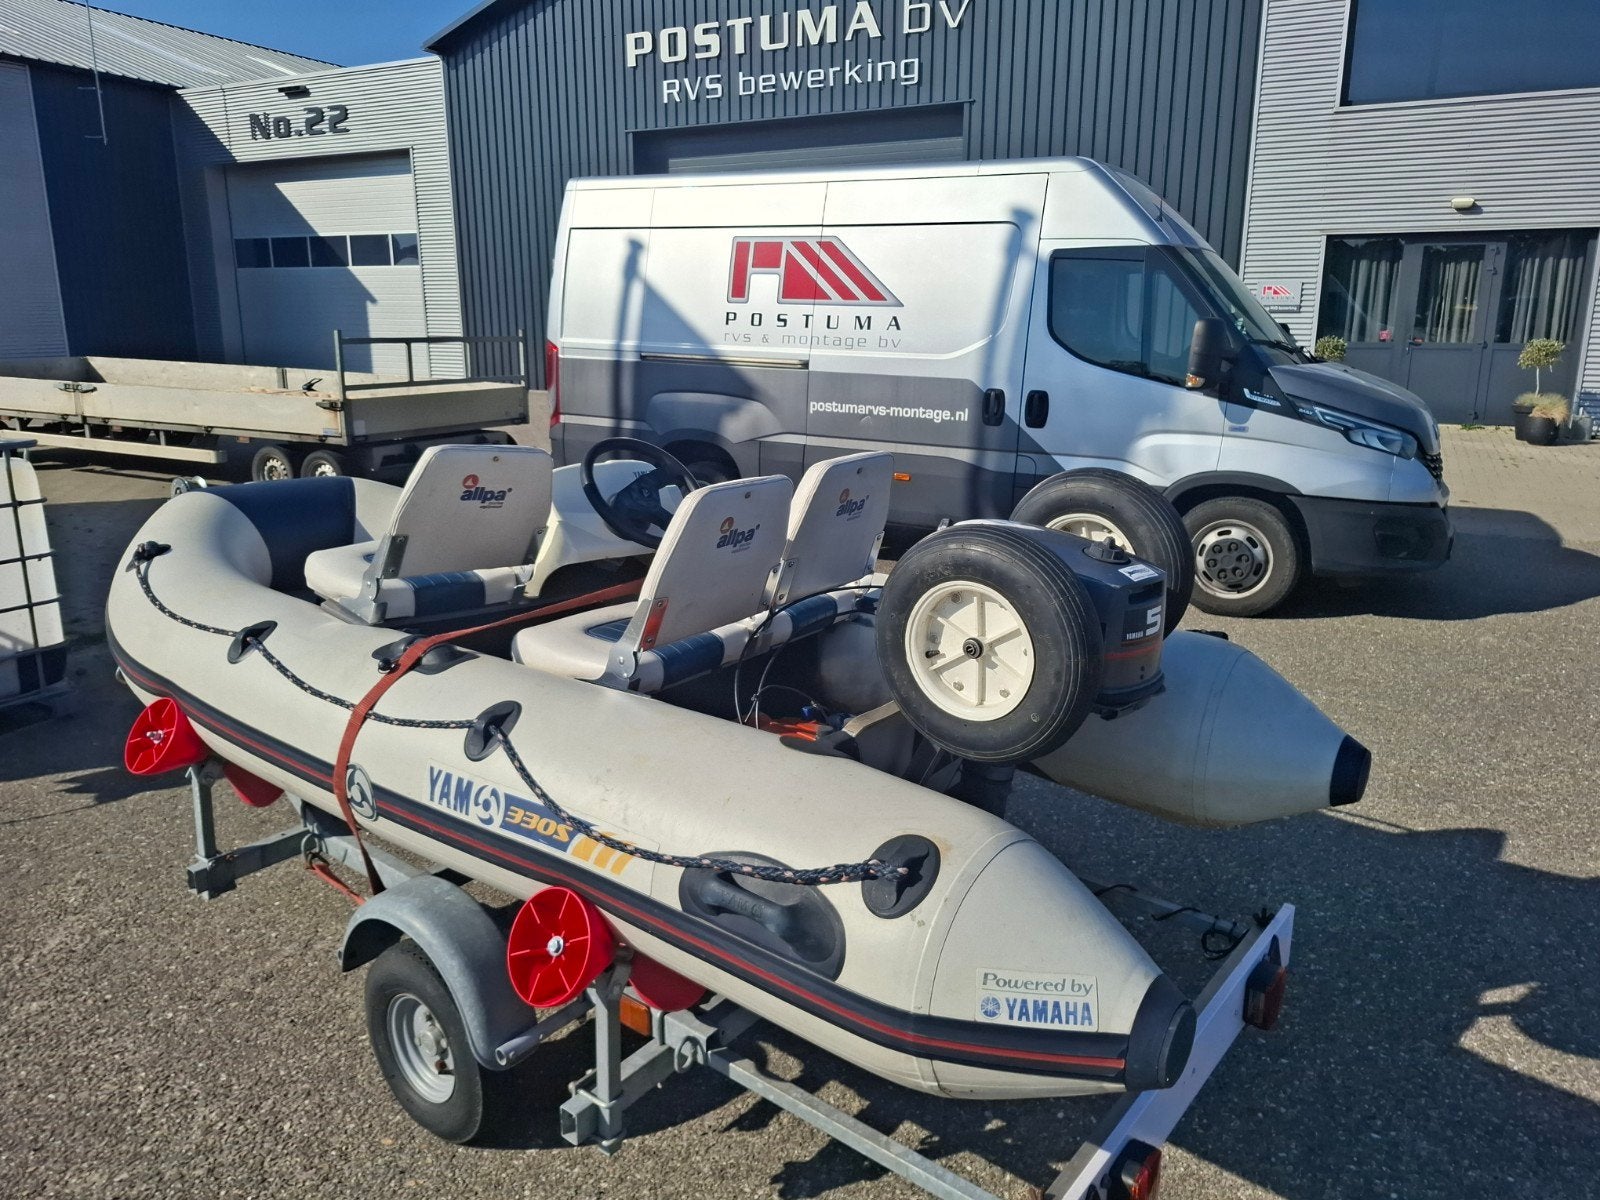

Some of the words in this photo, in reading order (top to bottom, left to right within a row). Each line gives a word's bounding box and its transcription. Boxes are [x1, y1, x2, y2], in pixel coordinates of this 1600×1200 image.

[626, 1, 881, 67] POSTUMA
[903, 0, 970, 34] bv
[663, 74, 723, 103] RVS
[738, 57, 919, 96] bewerking
[249, 104, 350, 140] No.22
[725, 311, 902, 331] POSTUMA
[724, 332, 752, 343] rvs
[761, 333, 770, 344] &
[781, 335, 867, 350] montage
[878, 335, 902, 349] bv
[809, 401, 969, 423] postumarvs-montage.nl
[1145, 604, 1162, 637] 5
[982, 972, 1067, 993] Powered
[1070, 979, 1094, 997] by
[1005, 997, 1093, 1027] YAMAHA
